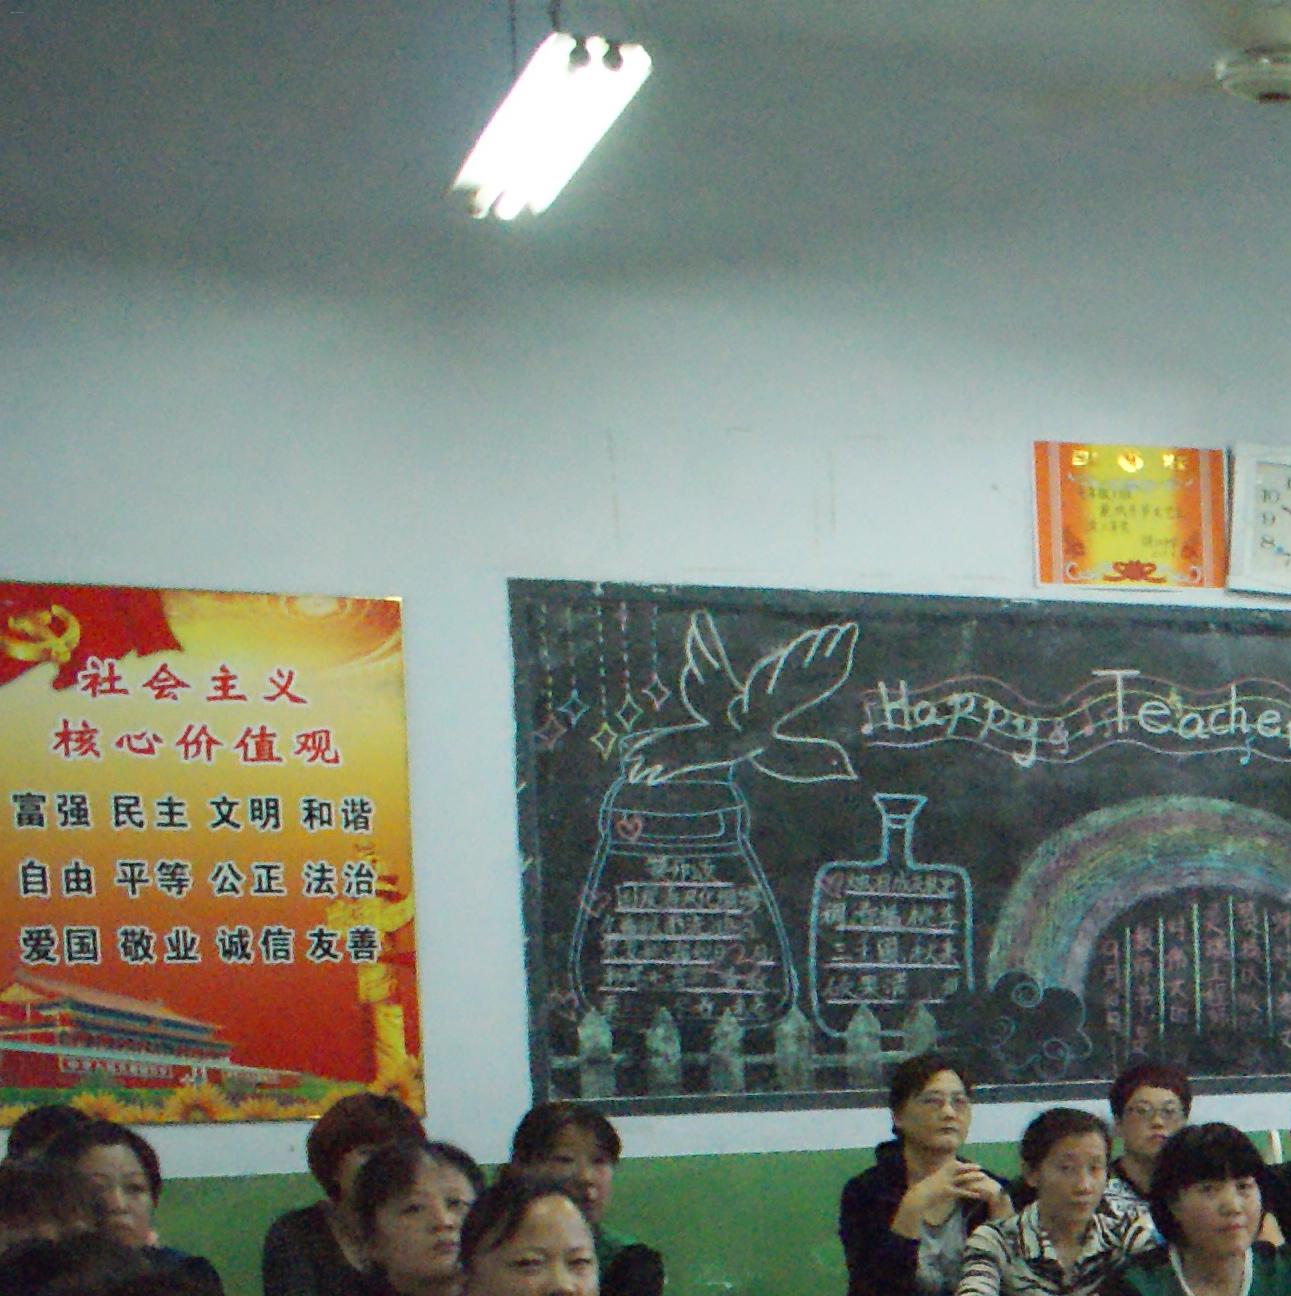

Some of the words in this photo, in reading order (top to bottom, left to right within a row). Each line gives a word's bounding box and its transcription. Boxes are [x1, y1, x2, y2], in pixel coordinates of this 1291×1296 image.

[80, 659, 308, 704] 社会主义
[52, 718, 340, 765] 核心价值观
[877, 679, 1039, 768] Happy
[12, 791, 91, 829] 富强
[112, 794, 189, 830] 民主
[209, 795, 281, 831] 文明
[301, 796, 374, 833] 和谐
[20, 860, 94, 897] 自由
[115, 860, 192, 897] 平等
[210, 861, 286, 897] 公正
[303, 861, 376, 898] 法治
[21, 925, 98, 964] 爱国
[120, 926, 200, 963] 敬业
[218, 926, 294, 963] 诚信
[308, 927, 381, 964] 友善
